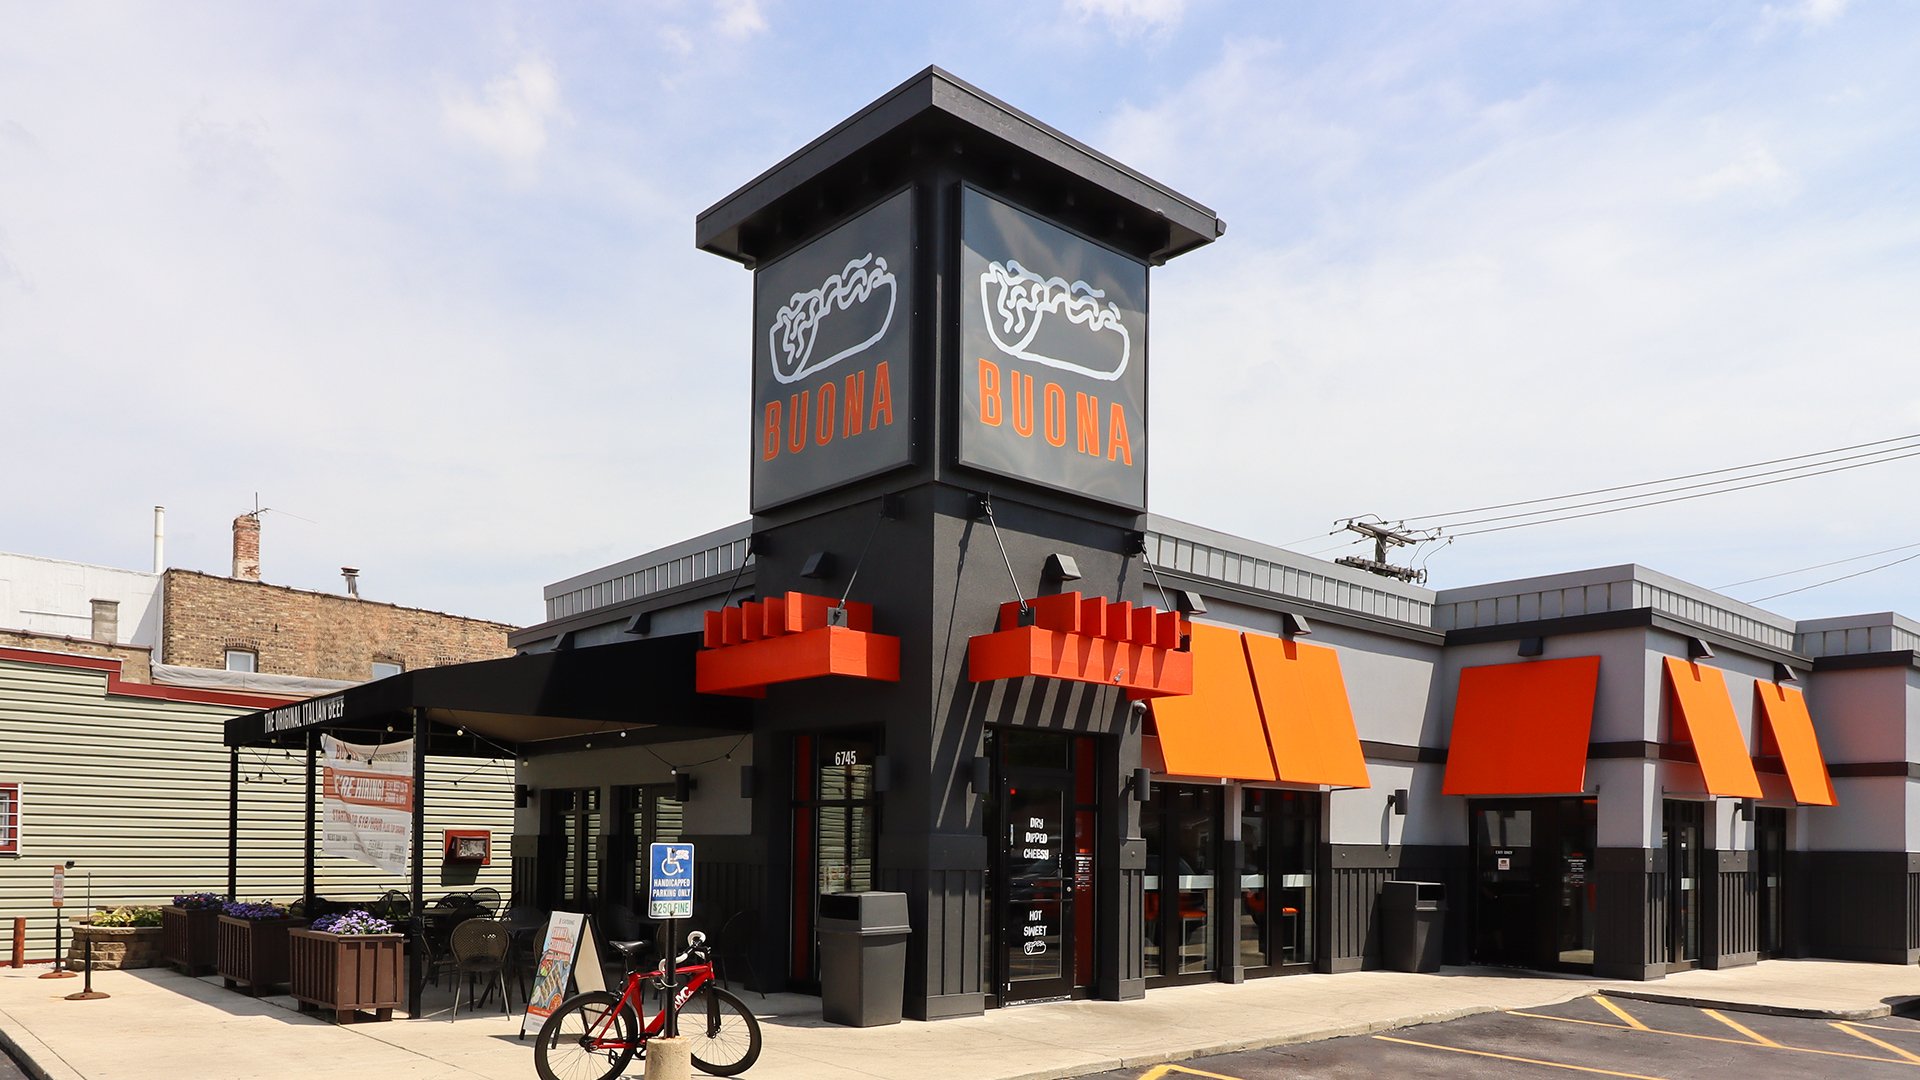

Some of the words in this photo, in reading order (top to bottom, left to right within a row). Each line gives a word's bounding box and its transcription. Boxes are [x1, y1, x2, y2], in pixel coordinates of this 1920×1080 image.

[763, 360, 893, 462] BUONA
[978, 358, 1133, 466] BUONA
[264, 711, 275, 734] THE
[275, 705, 302, 731] ORIGINAL
[302, 699, 327, 726] ITALIAN
[327, 695, 345, 720] BEEF
[835, 750, 857, 766] 6745
[355, 777, 385, 802] HIRING!
[1030, 817, 1044, 829] DRY
[1025, 832, 1048, 844] DIPPED
[1023, 848, 1050, 860] CHEESY
[653, 879, 691, 887] HANDICAPPED
[652, 888, 677, 897] PARKING
[678, 888, 690, 897] ONLY
[652, 902, 672, 914] $250
[673, 902, 689, 914] FINE
[1029, 910, 1042, 921] HOT
[1023, 925, 1048, 936] SWEET
